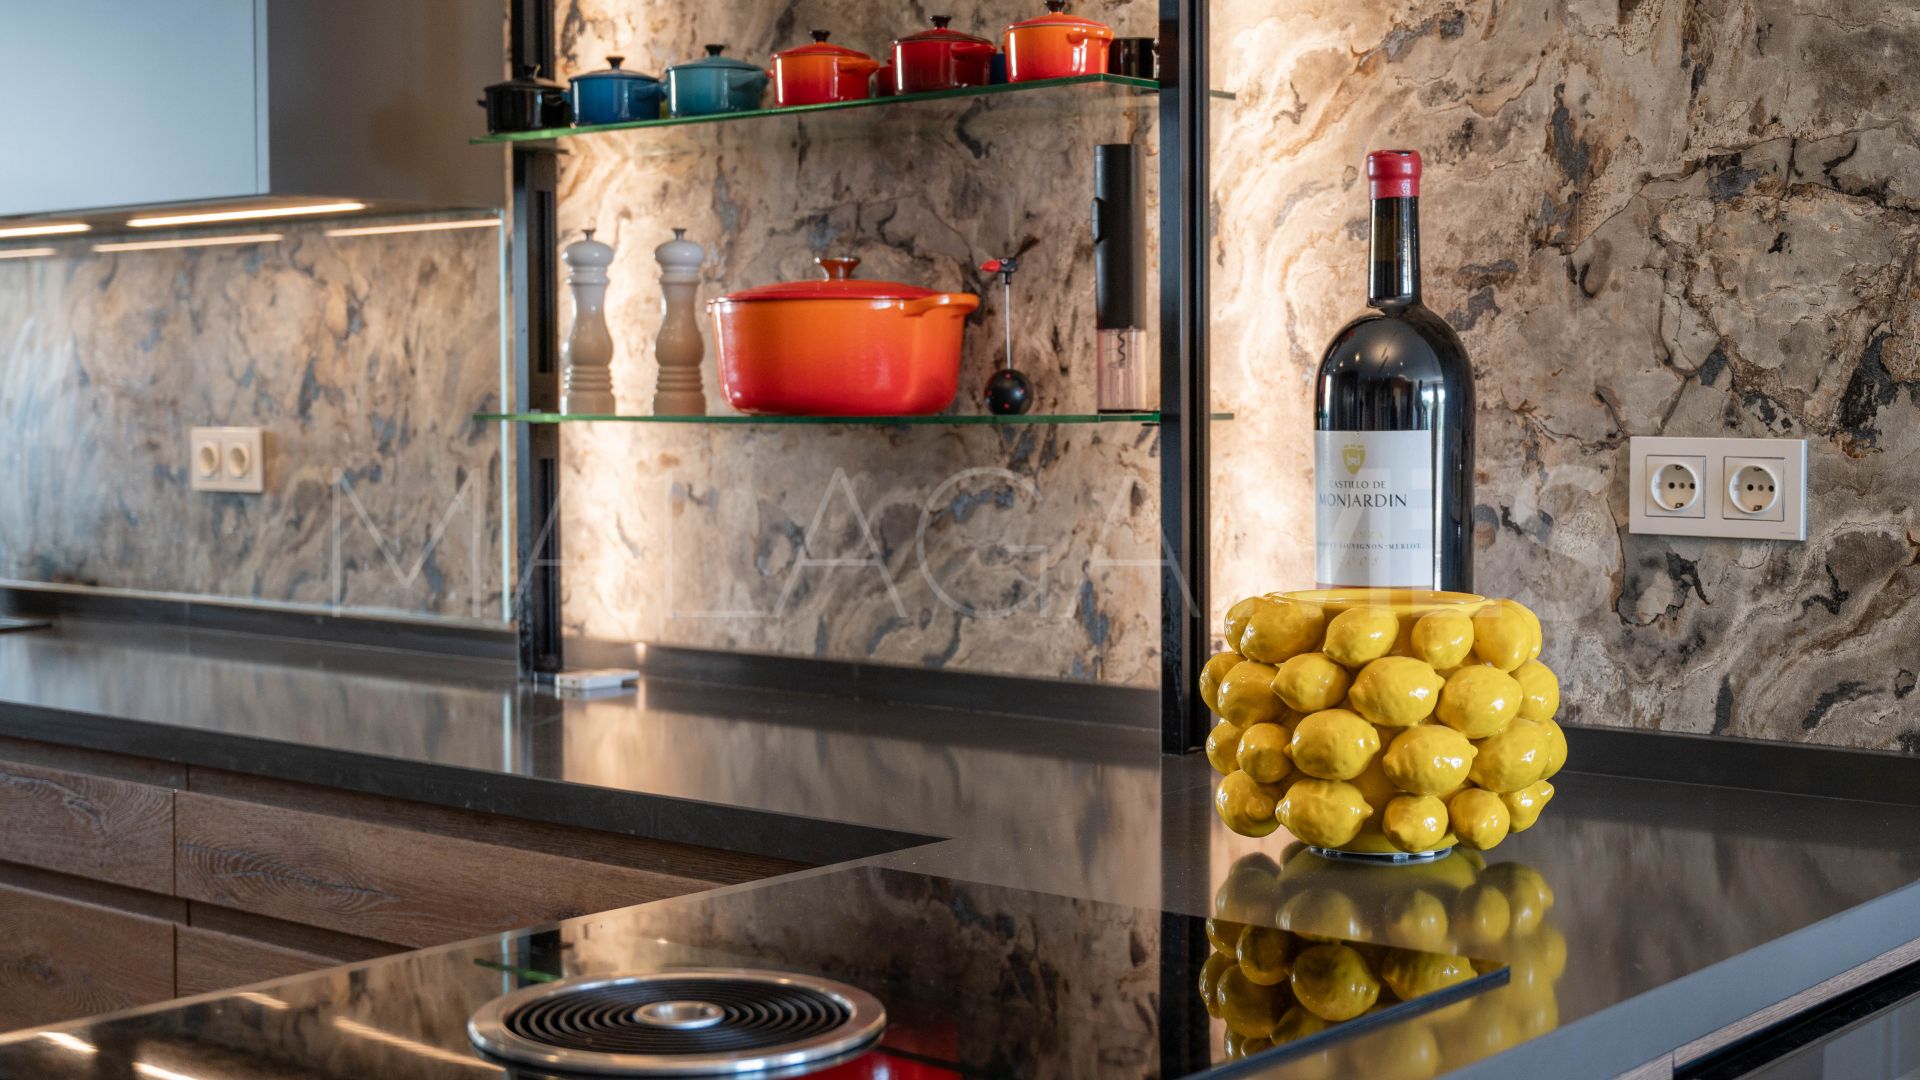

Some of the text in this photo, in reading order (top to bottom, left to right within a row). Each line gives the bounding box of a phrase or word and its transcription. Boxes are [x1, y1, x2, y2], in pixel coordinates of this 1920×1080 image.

[1329, 480, 1386, 489] CASTILLO DE
[1319, 493, 1407, 508] MONJARDIN
